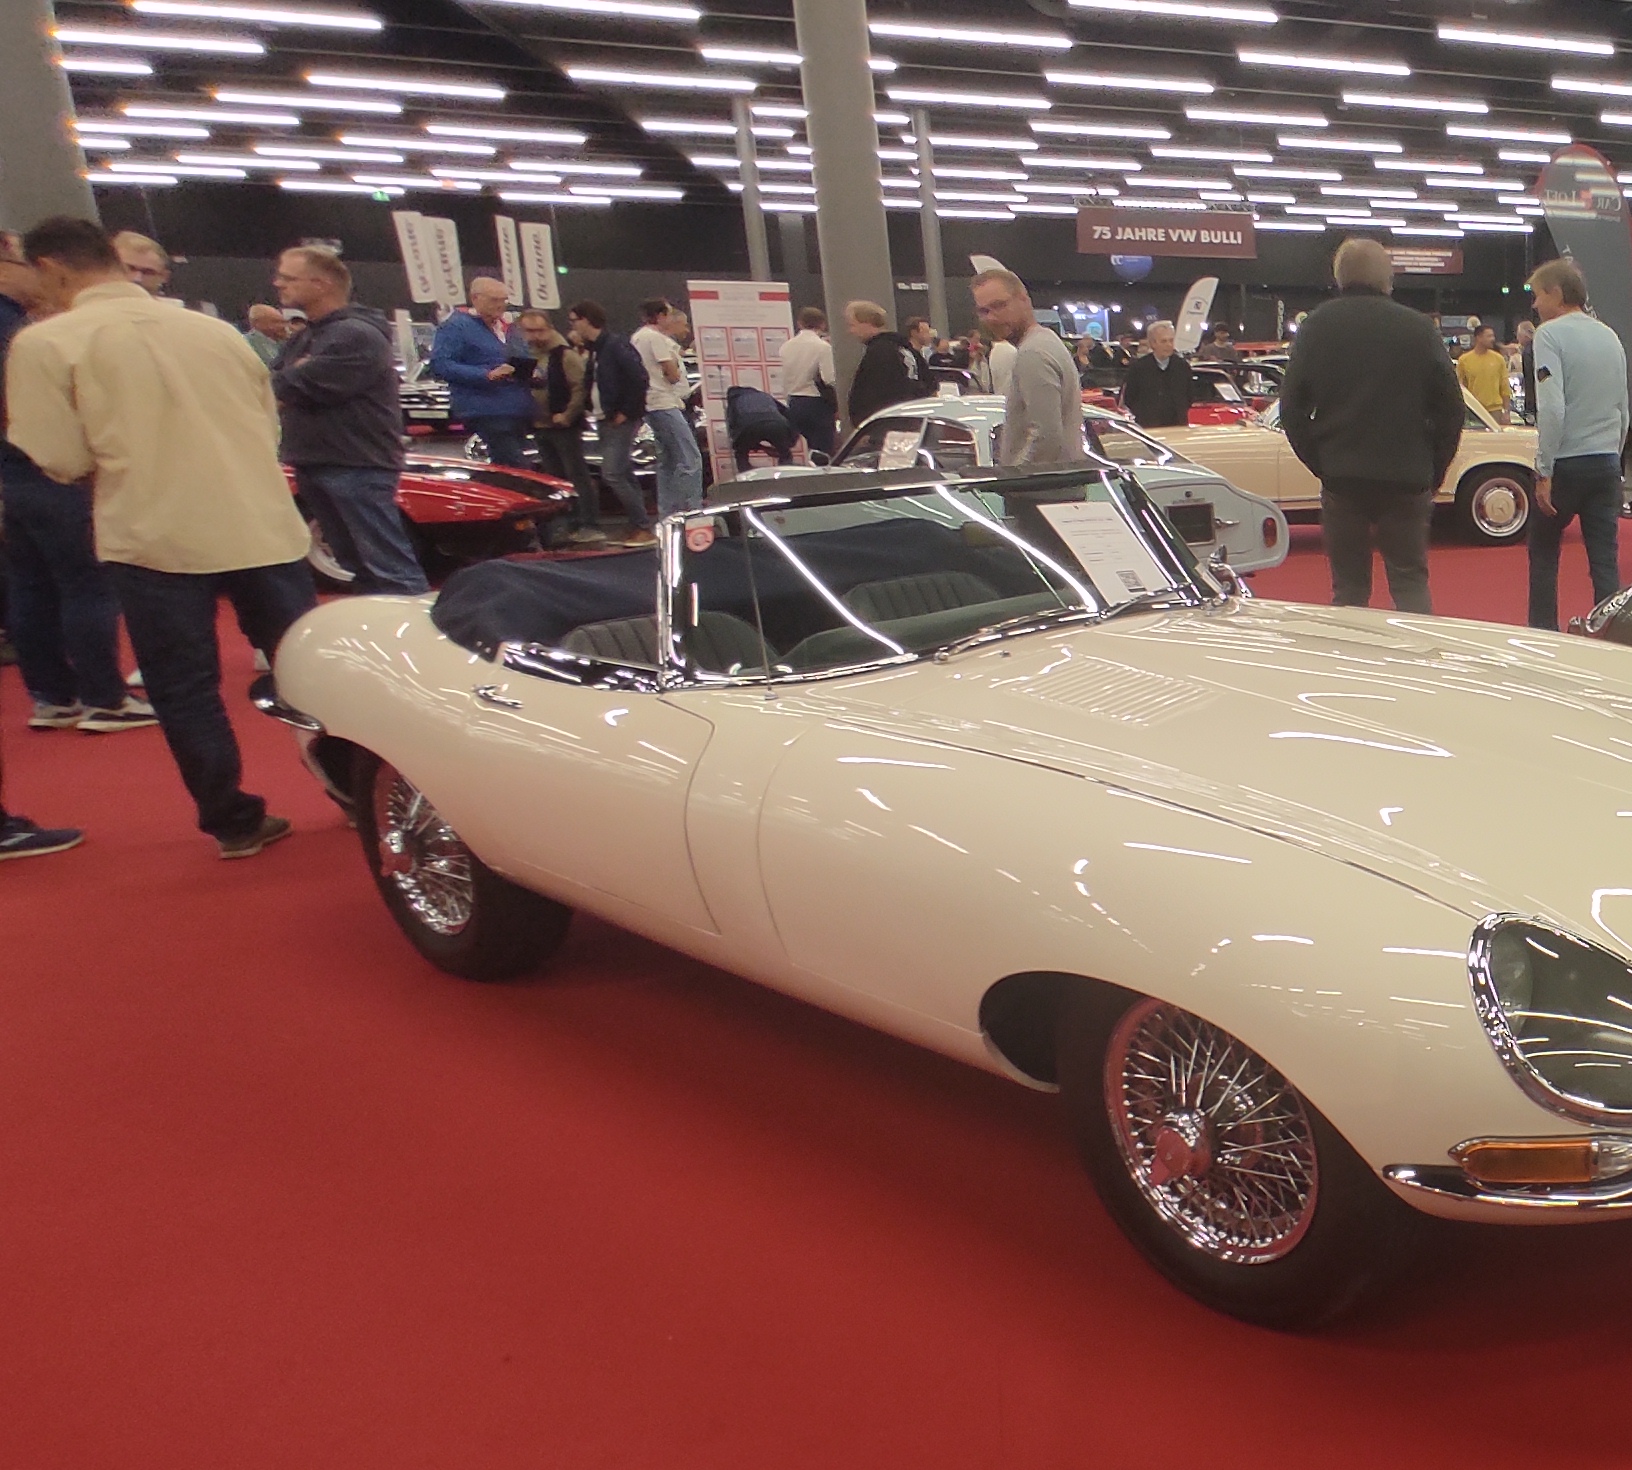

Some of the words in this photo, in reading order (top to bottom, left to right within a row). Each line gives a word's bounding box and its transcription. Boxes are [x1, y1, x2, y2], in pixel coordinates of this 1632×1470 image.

[1092, 225, 1112, 240] 75
[1115, 226, 1166, 242] JAHRE
[1168, 228, 1197, 243] VW
[1199, 229, 1242, 245] BULLI
